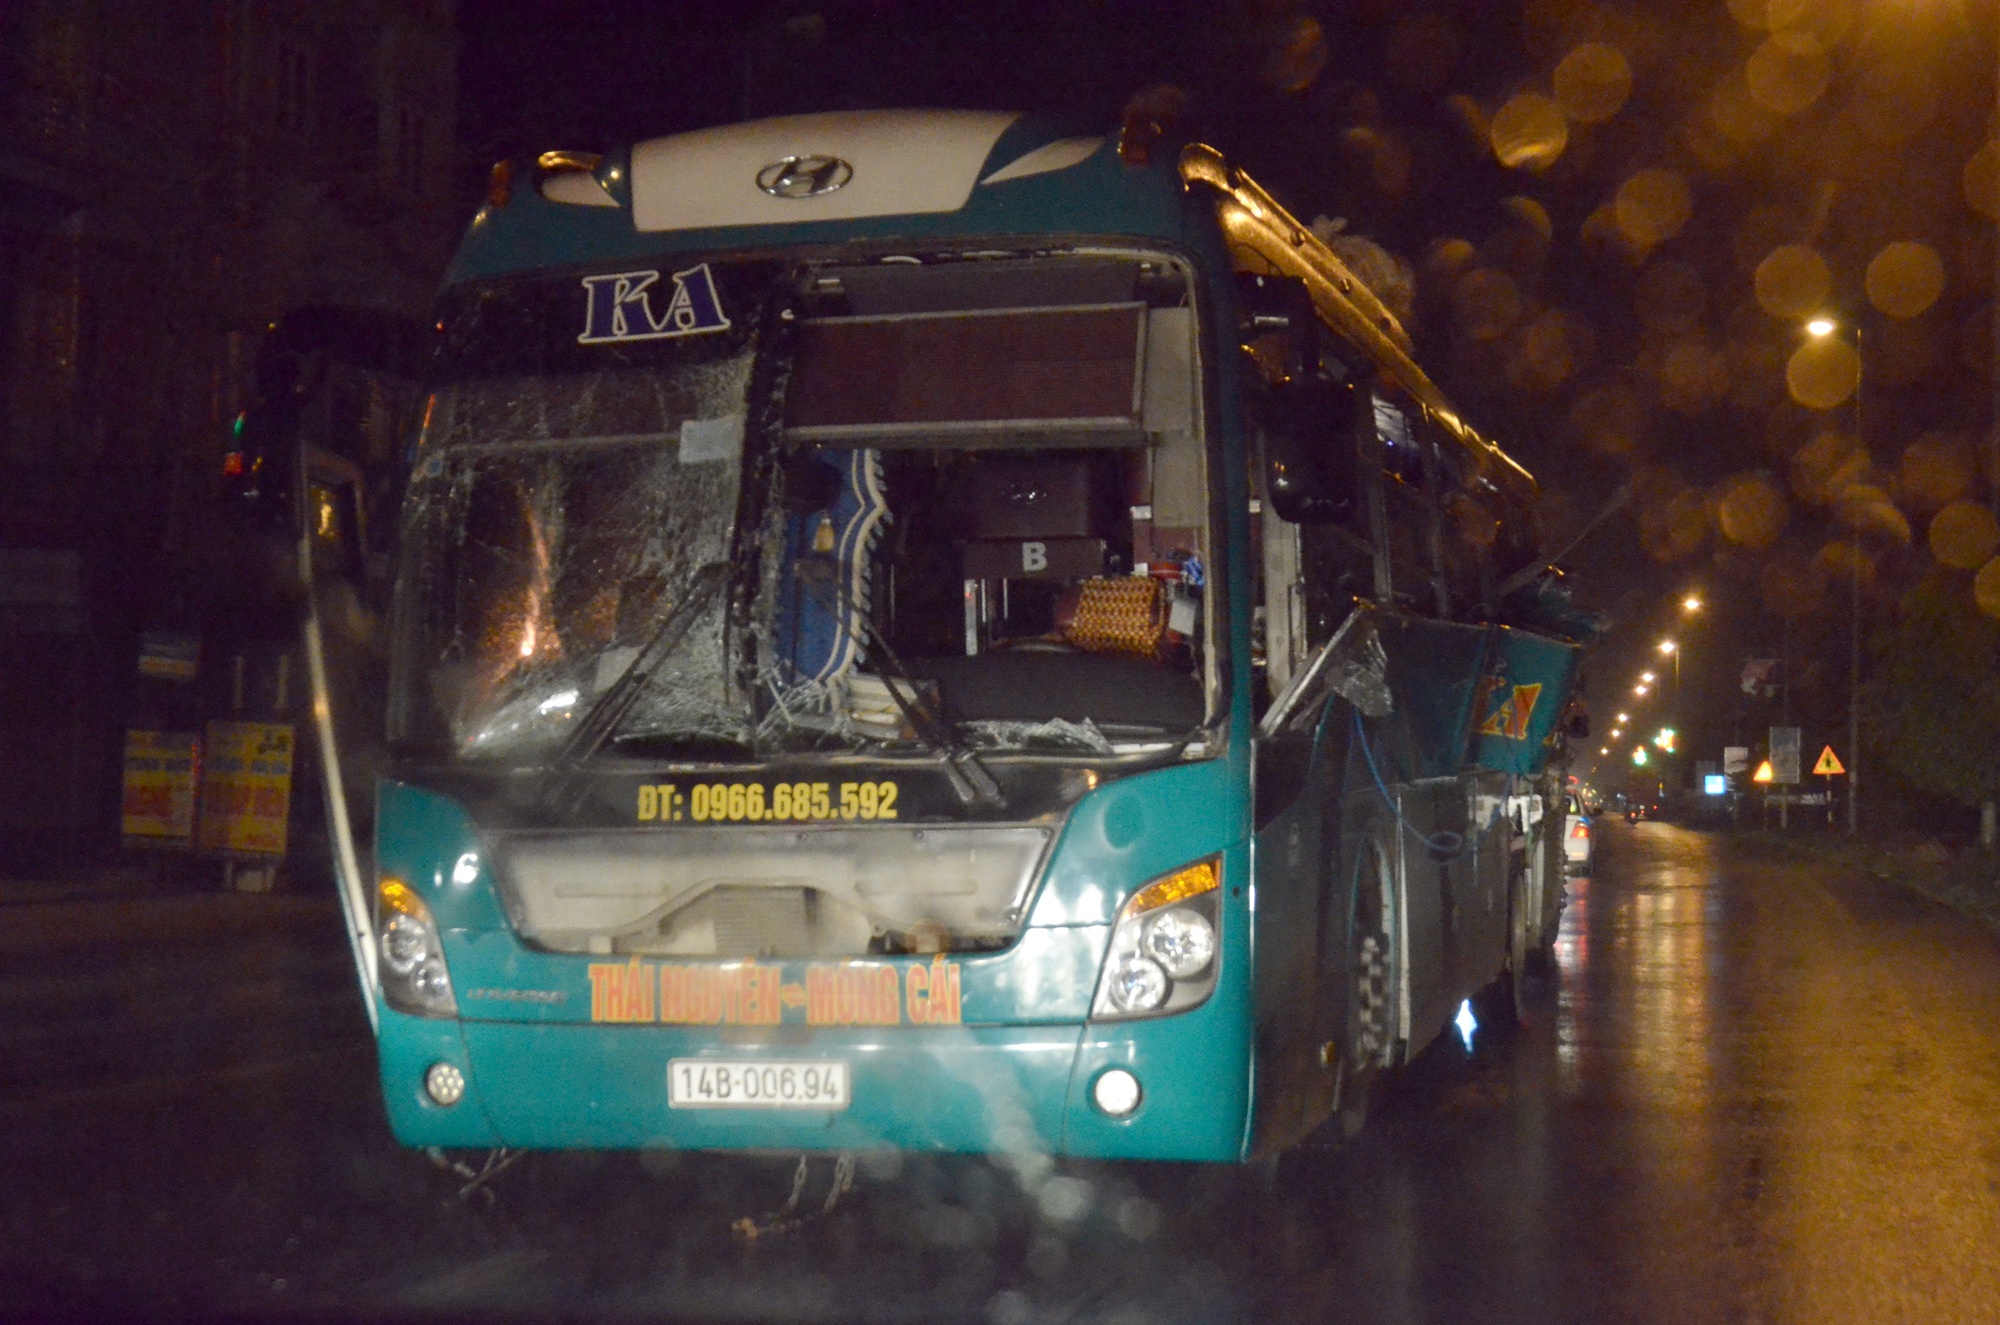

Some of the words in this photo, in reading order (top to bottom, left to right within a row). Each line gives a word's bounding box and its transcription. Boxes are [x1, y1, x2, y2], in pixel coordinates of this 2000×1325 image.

[1022, 541, 1047, 572] B
[691, 781, 898, 821] 0966.685.592
[588, 955, 655, 1023] THÁI
[906, 953, 961, 1024] CÁI
